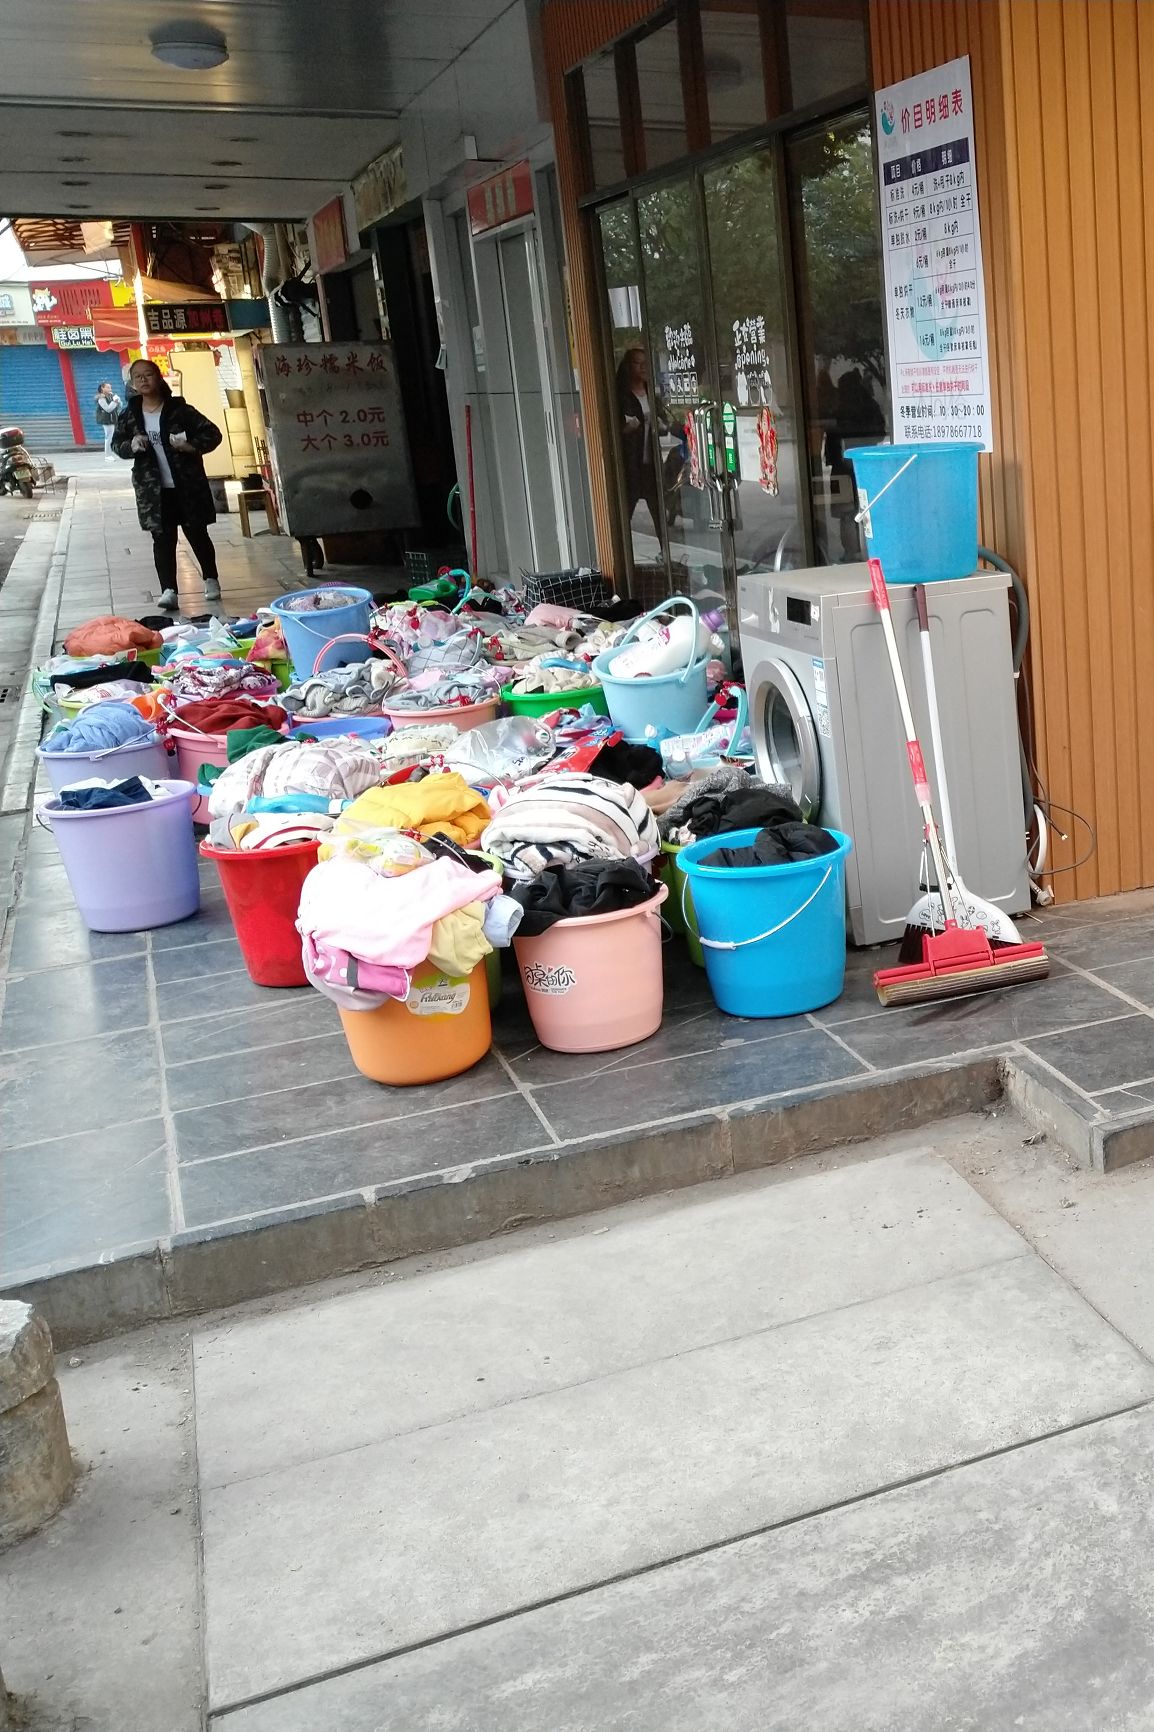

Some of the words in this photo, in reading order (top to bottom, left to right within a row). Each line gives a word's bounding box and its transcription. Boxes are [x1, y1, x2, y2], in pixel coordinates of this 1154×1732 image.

[901, 88, 964, 135] 价目明细表
[297, 409, 333, 427] 中个
[340, 406, 386, 424] 2.0元
[301, 433, 338, 452] 大个
[343, 431, 389, 447] 3.0元
